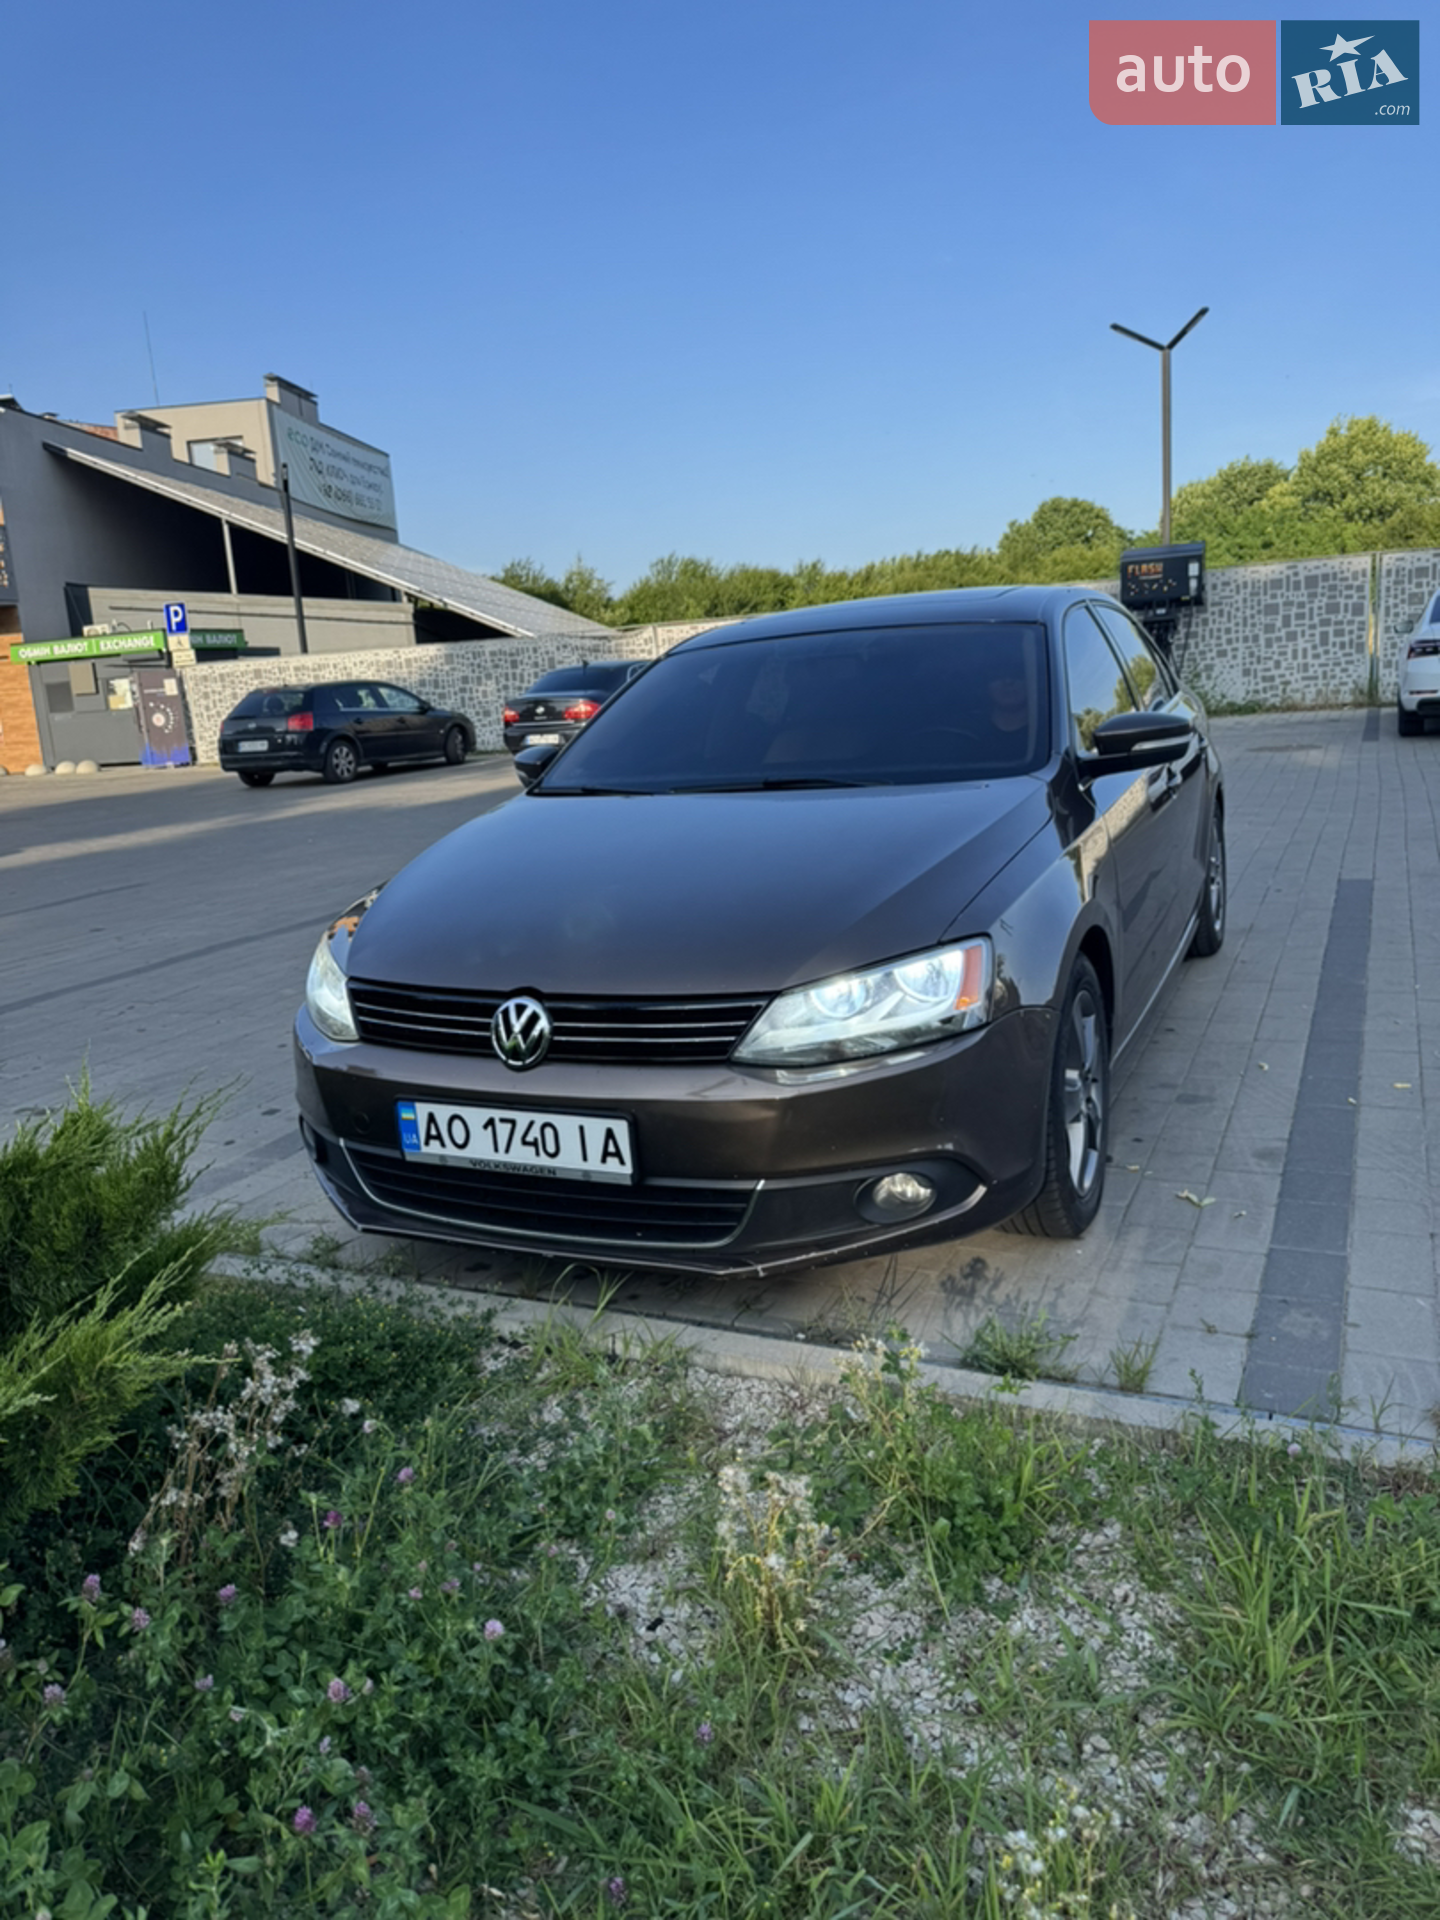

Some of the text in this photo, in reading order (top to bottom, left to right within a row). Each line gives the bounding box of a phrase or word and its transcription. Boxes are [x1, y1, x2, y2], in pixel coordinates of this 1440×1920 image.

[169, 605, 184, 631] P
[18, 641, 88, 659] ОБМІН ВАЛЮТ
[99, 635, 156, 651] EXCHANGE
[423, 1111, 627, 1167] AO 1740 IA
[469, 1159, 557, 1177] VOLKSWAGEN
